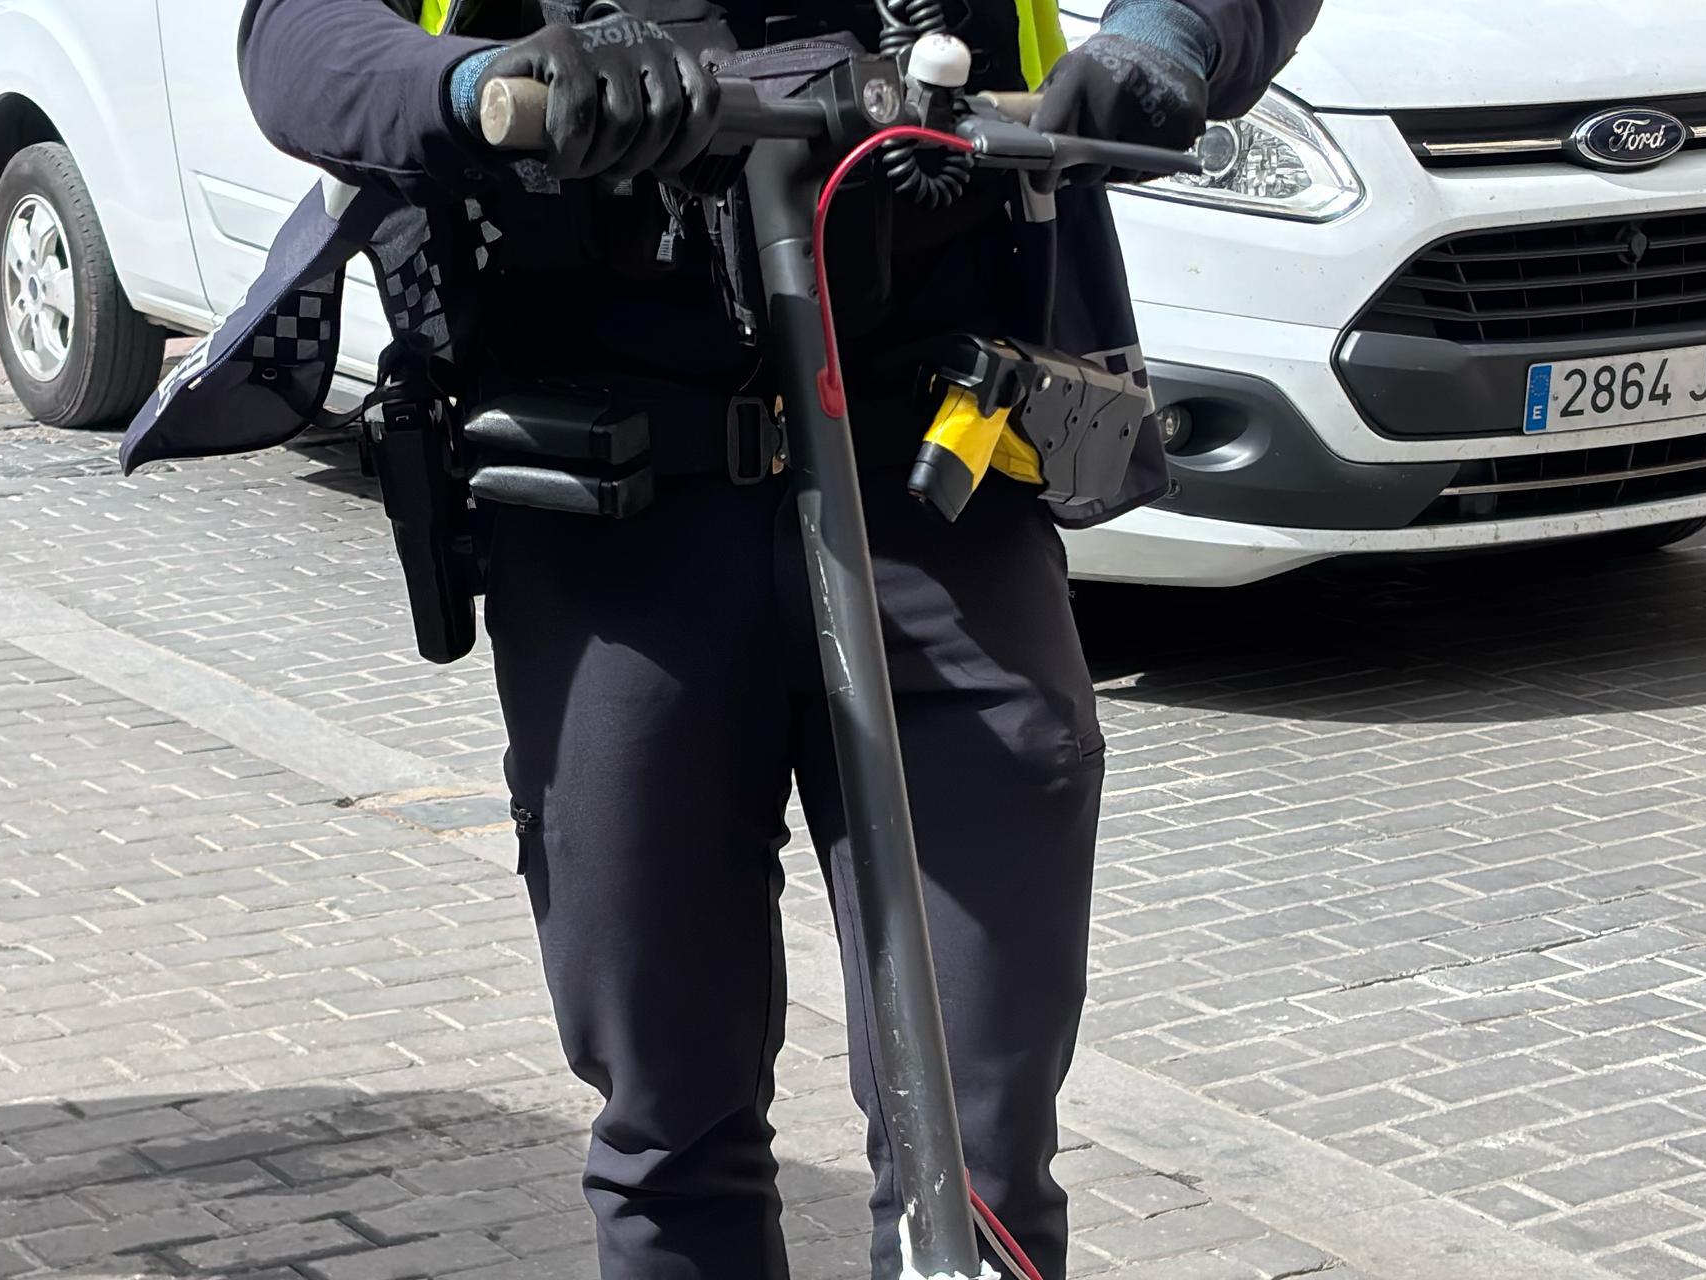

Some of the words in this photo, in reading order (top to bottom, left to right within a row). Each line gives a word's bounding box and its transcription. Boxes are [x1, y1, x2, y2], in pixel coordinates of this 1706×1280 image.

[1608, 118, 1667, 152] Ford
[1559, 357, 1673, 418] 2864
[1532, 405, 1543, 420] E
